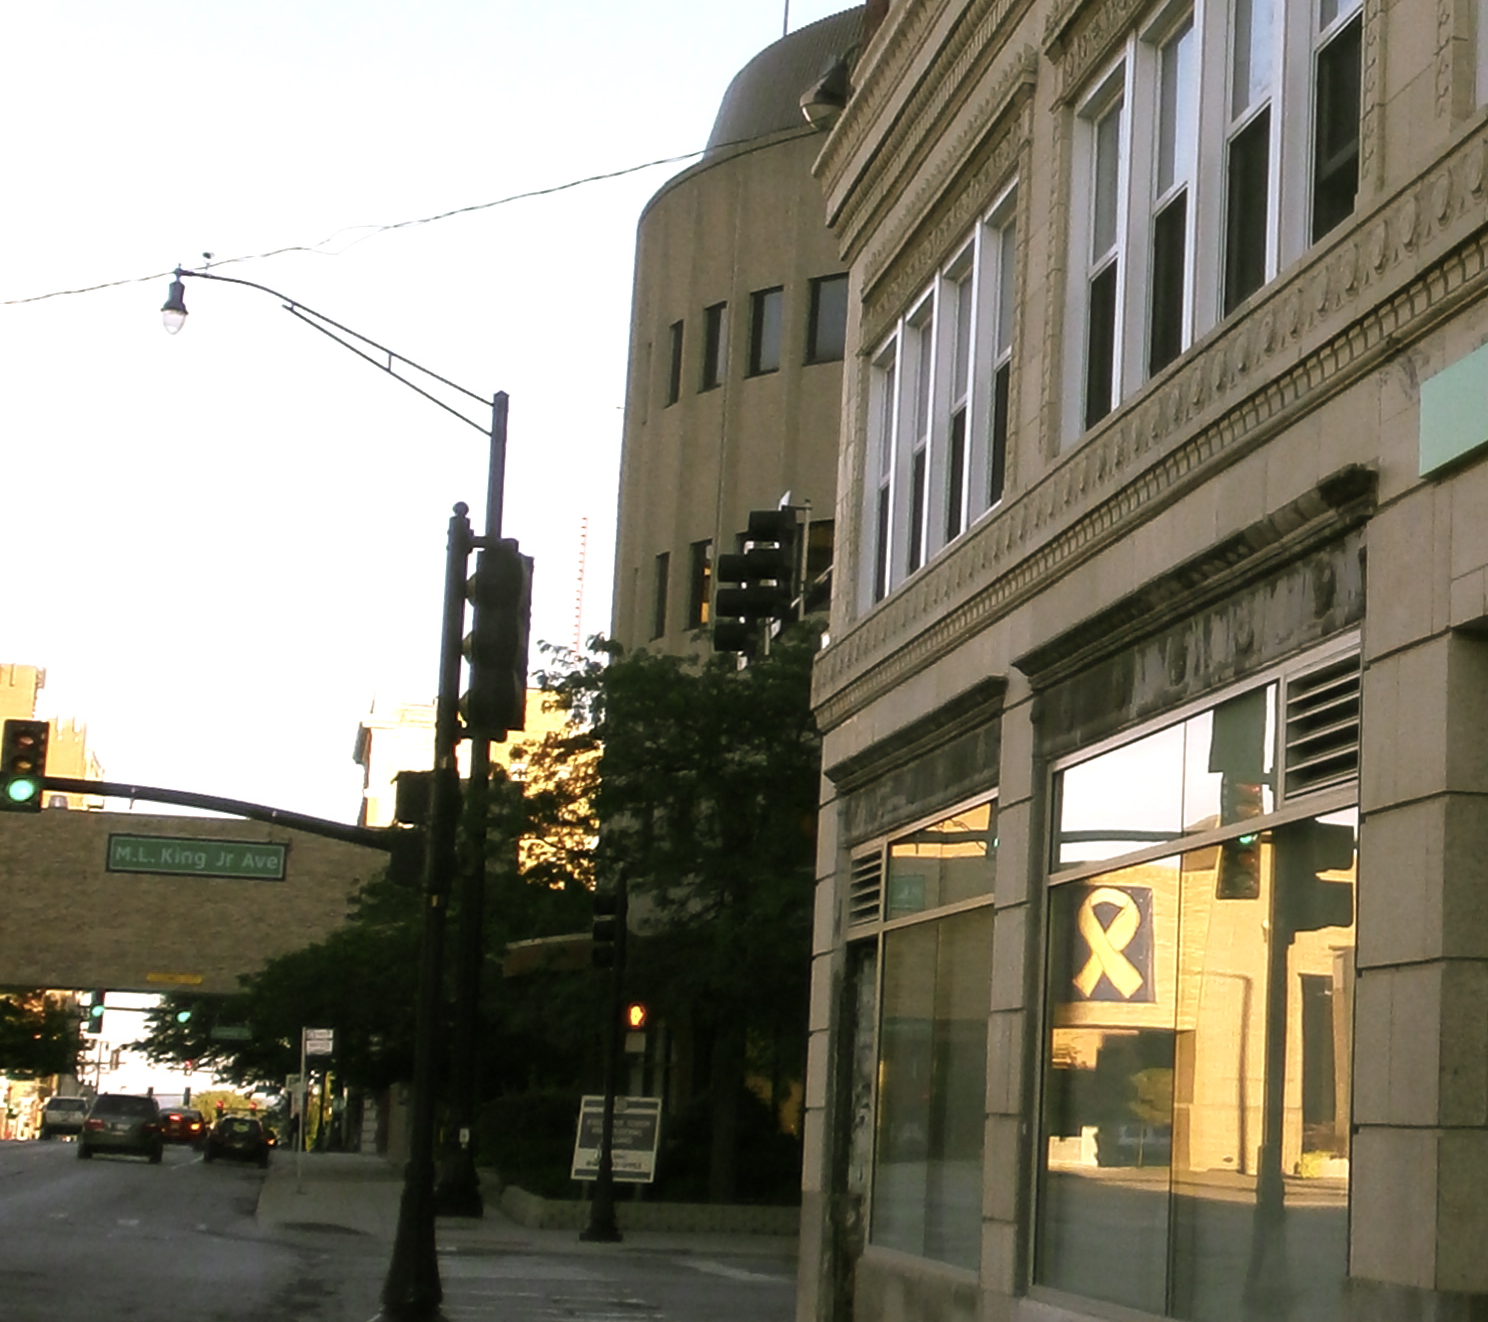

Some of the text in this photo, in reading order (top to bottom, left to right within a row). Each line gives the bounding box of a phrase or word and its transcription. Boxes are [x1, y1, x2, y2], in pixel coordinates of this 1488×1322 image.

[115, 846, 279, 869] M.L. King Jr Ave
